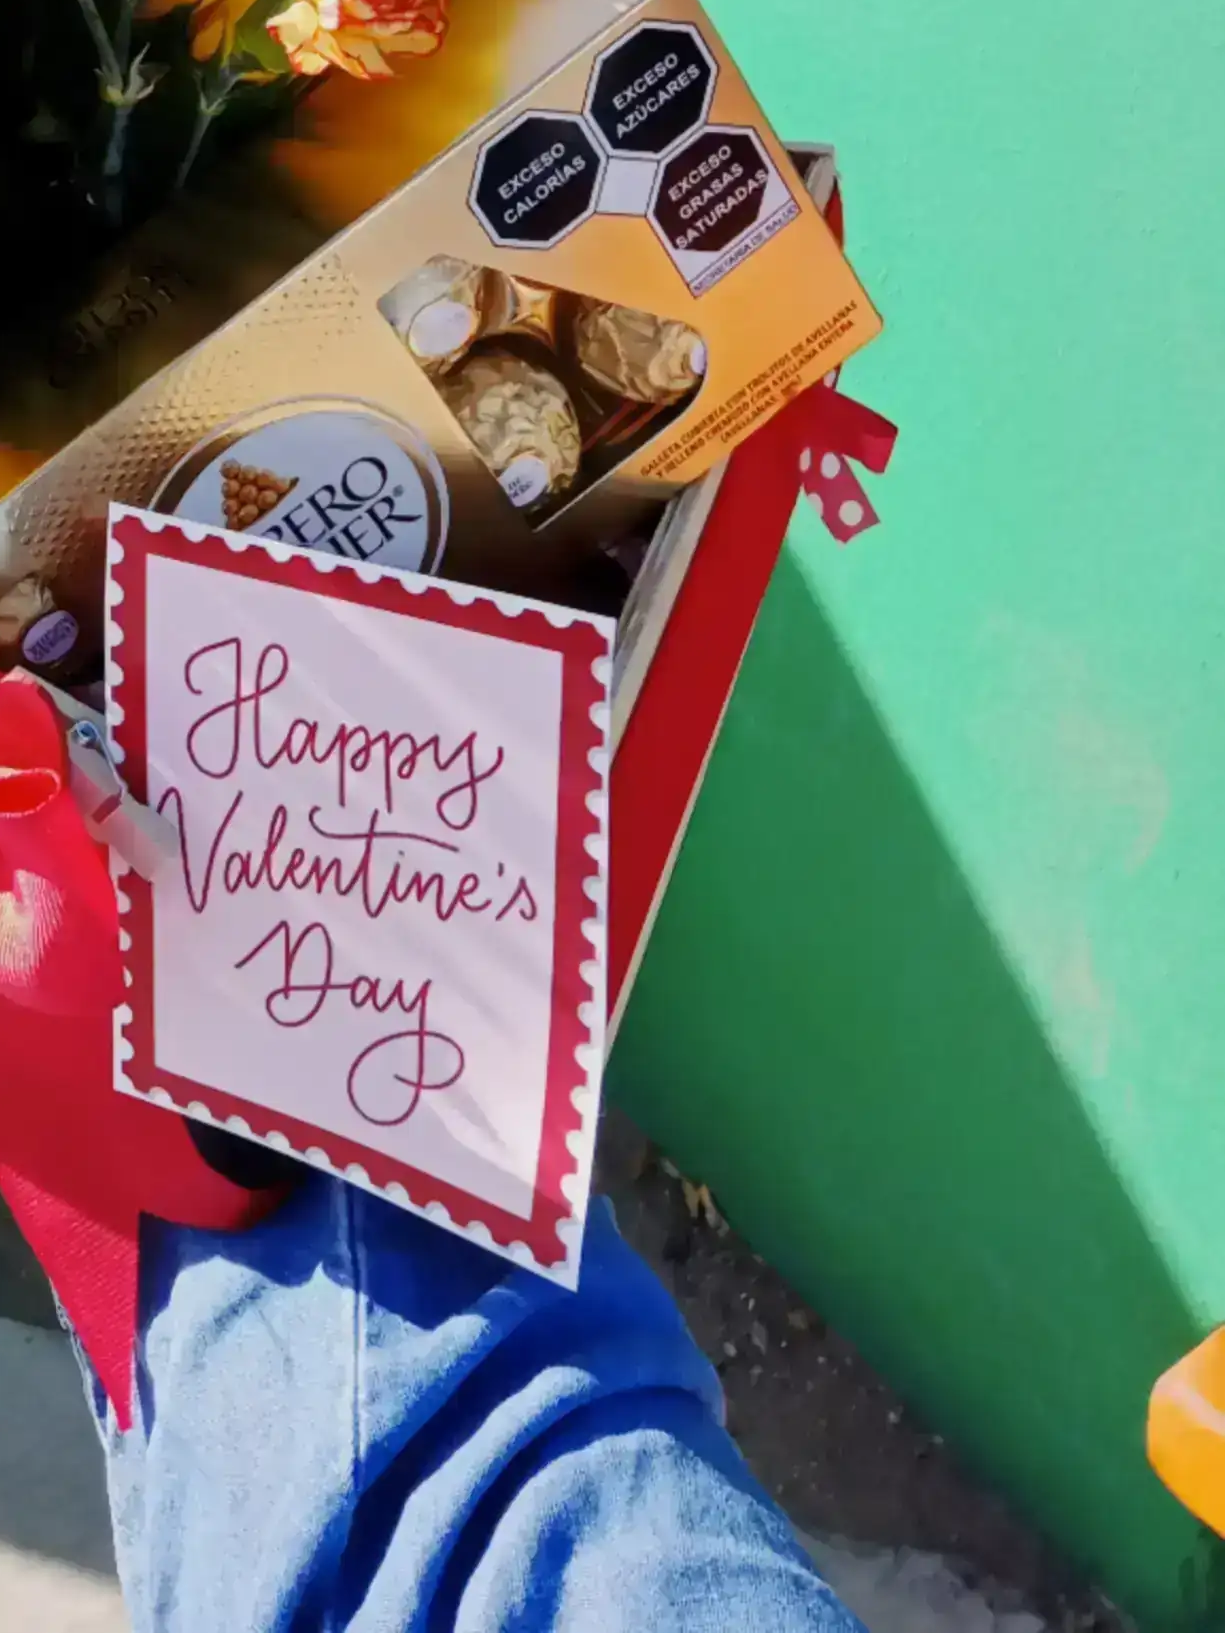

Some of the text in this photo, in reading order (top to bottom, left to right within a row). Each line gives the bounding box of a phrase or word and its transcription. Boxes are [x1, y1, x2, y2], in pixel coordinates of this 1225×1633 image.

[612, 53, 679, 110] EXCESO
[615, 64, 701, 140] AZÚCARES
[497, 142, 566, 200] EXCESO
[668, 145, 732, 202] EXCESO
[678, 163, 743, 220] GRASAS
[676, 169, 770, 250] SATURADAS
[183, 636, 504, 831] Happy
[156, 786, 539, 920] Valentine's
[235, 921, 465, 1126] Day
